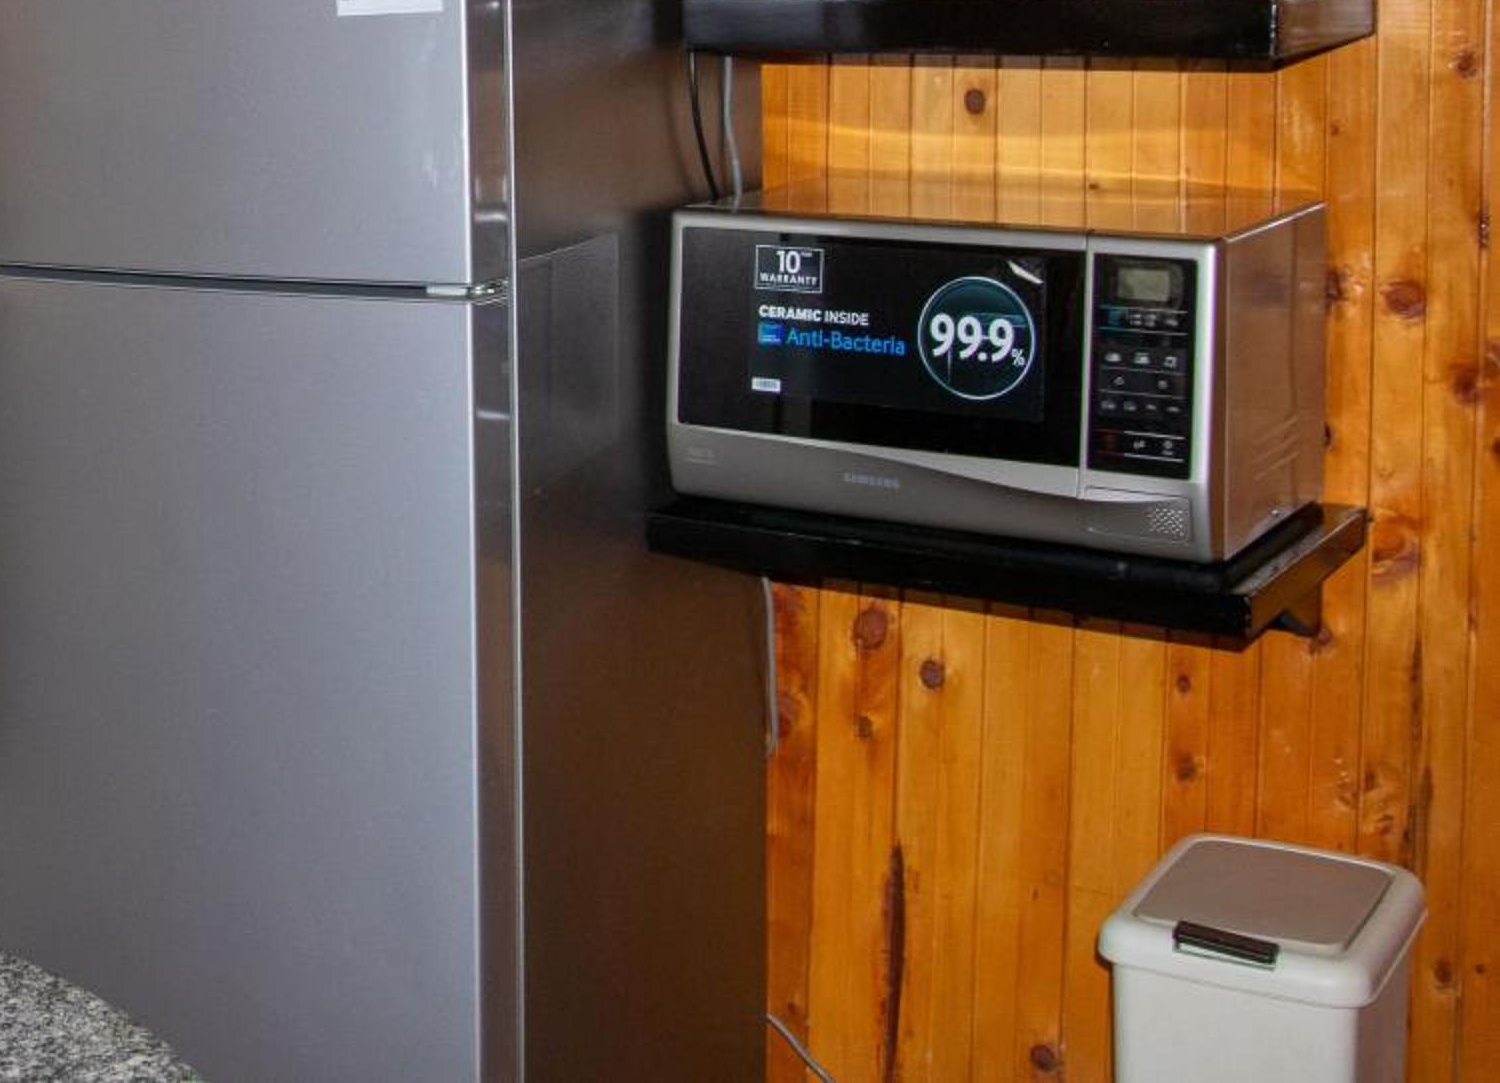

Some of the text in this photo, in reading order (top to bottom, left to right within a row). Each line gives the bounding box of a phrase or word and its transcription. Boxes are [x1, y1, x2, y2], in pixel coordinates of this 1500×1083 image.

[776, 250, 801, 274] 10
[758, 304, 869, 326] CERAMIC INSIDE
[786, 327, 905, 355] Anti-Bacteria
[930, 312, 1026, 366] 99.9%
